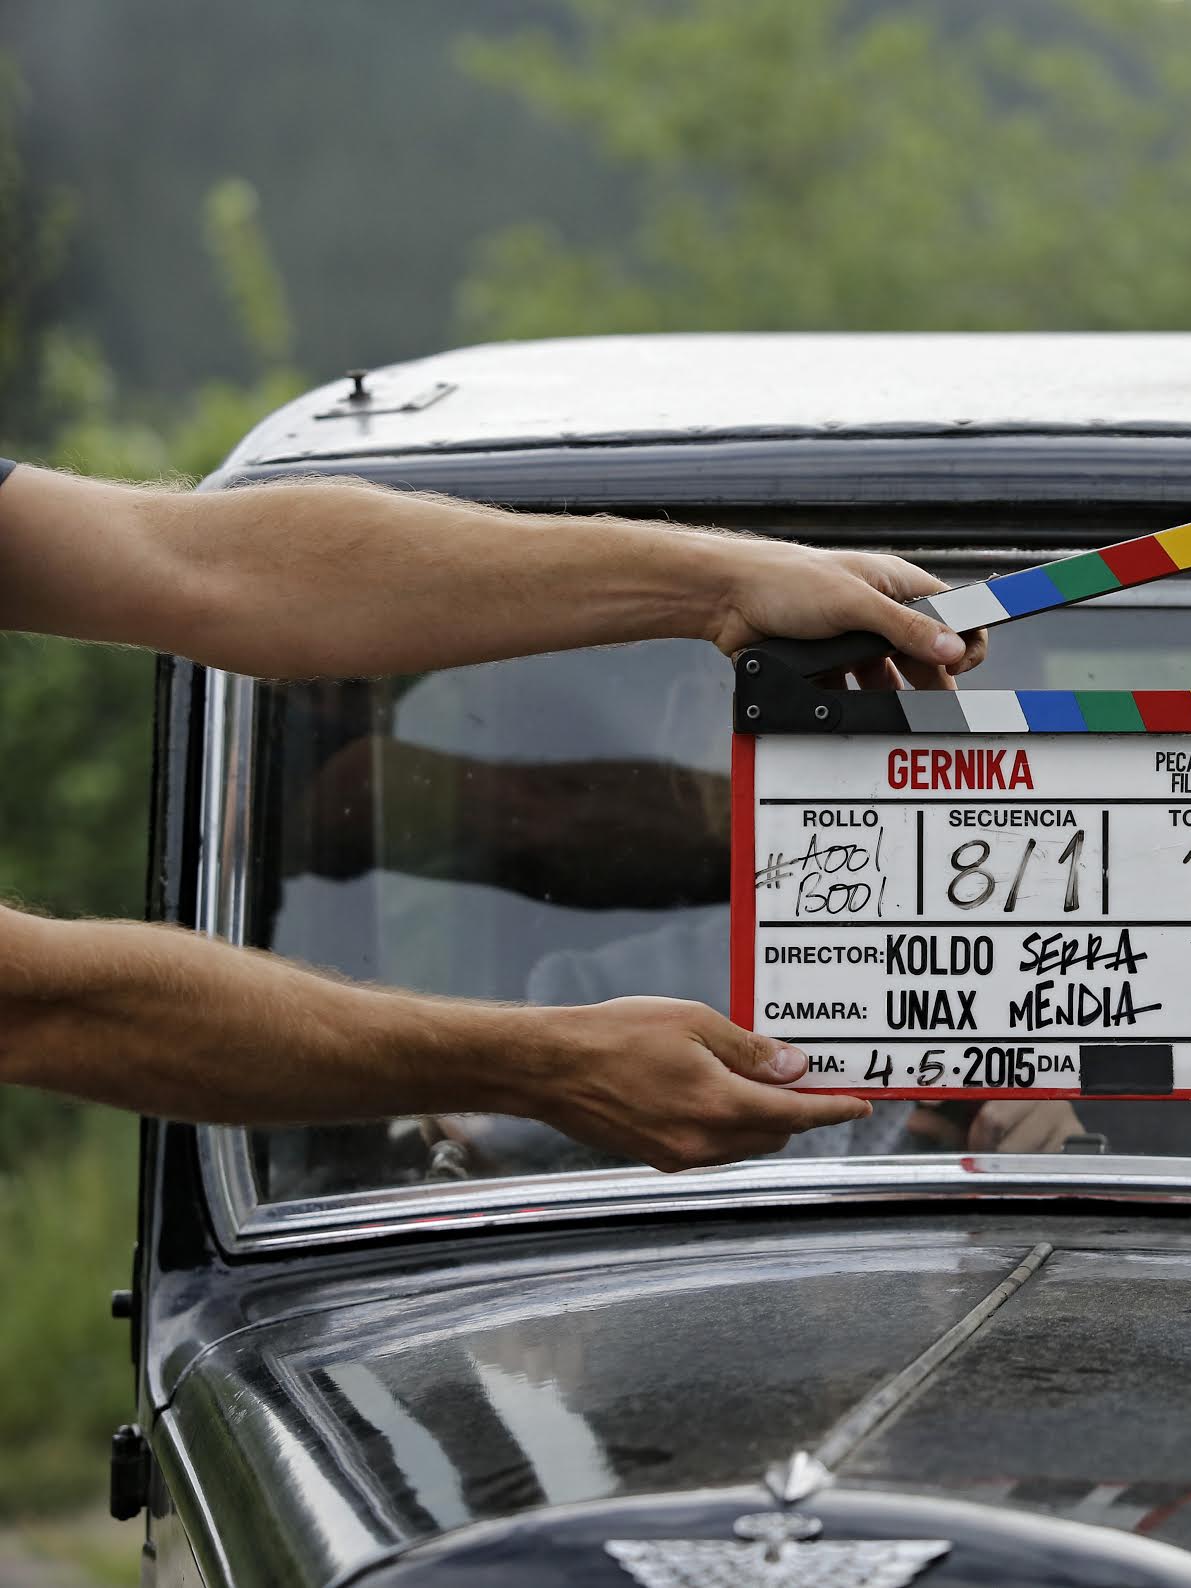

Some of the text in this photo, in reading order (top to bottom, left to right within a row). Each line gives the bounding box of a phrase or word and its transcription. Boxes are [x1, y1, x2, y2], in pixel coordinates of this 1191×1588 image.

[887, 748, 1035, 790] GERNIKA
[803, 809, 879, 827] ROLLO
[949, 808, 1077, 828] SECUENCIA
[764, 928, 1148, 976] DIRECTOR: KOLDO SERRA
[764, 980, 1162, 1032] CAMARA: UNAX MENDIA
